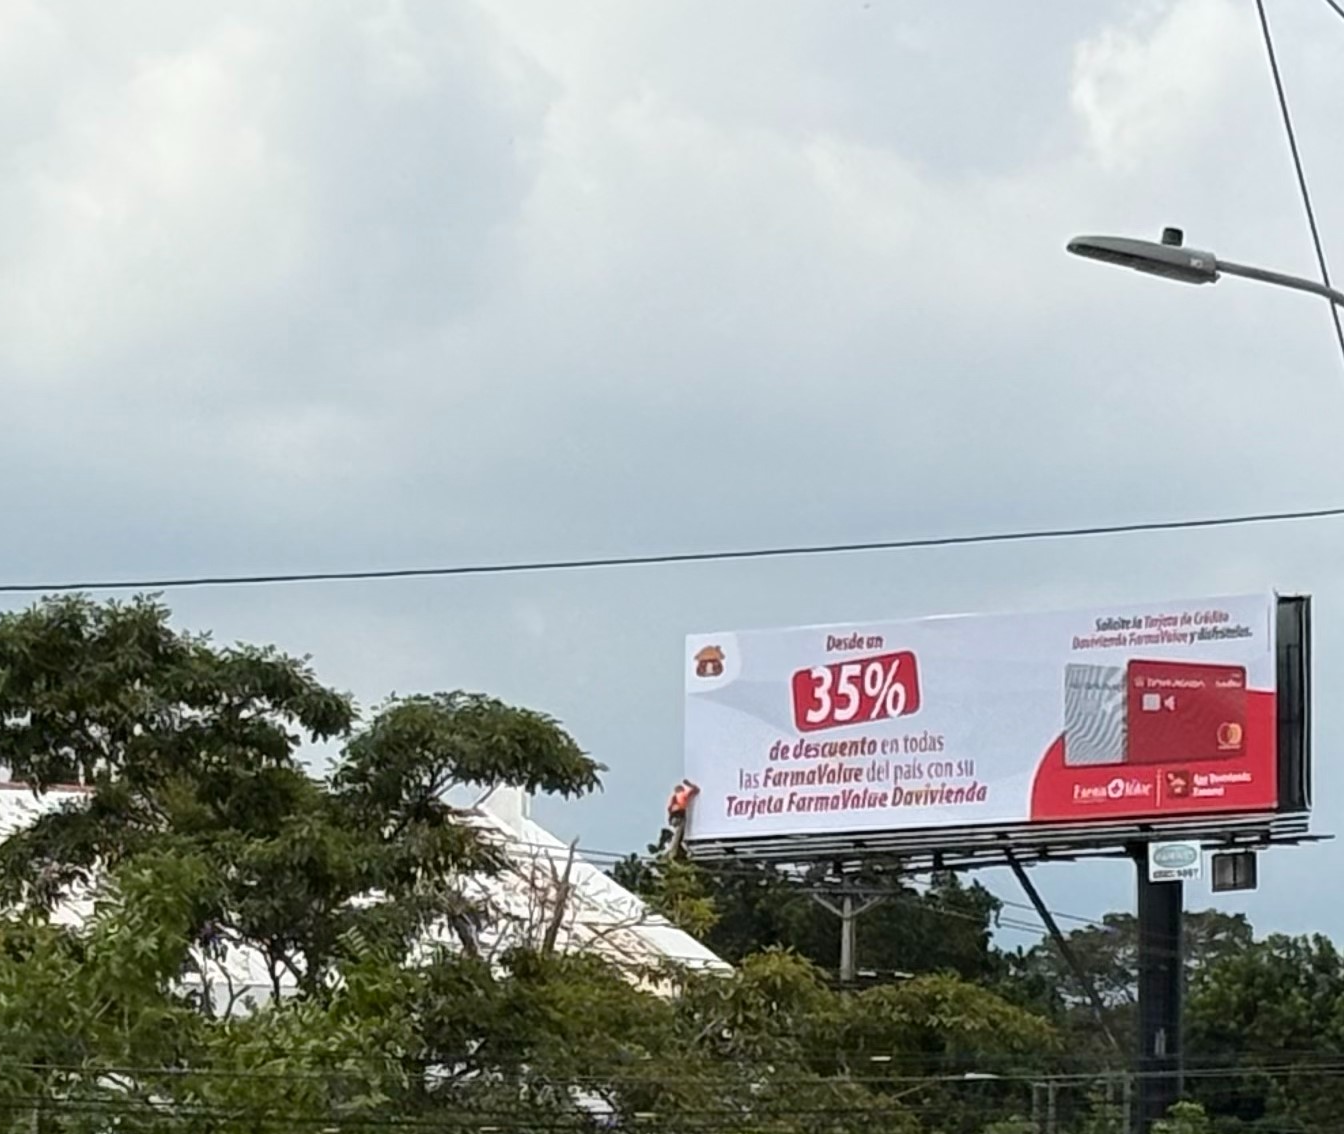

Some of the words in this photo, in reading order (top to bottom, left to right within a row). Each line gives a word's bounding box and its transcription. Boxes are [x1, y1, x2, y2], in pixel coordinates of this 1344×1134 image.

[827, 632, 864, 652] Desde
[866, 636, 883, 650] un
[806, 659, 906, 724] 35%
[769, 740, 790, 761] de
[792, 737, 877, 761] descuento
[881, 738, 899, 755] en
[902, 730, 944, 754] todas
[739, 767, 760, 790] las
[762, 762, 863, 788] FarmaValue
[866, 759, 889, 783] del
[927, 761, 953, 779] con
[956, 759, 974, 778] su
[726, 793, 784, 821] Tarjeta
[786, 787, 888, 812] FarmaValue
[891, 780, 987, 807] Davivienda
